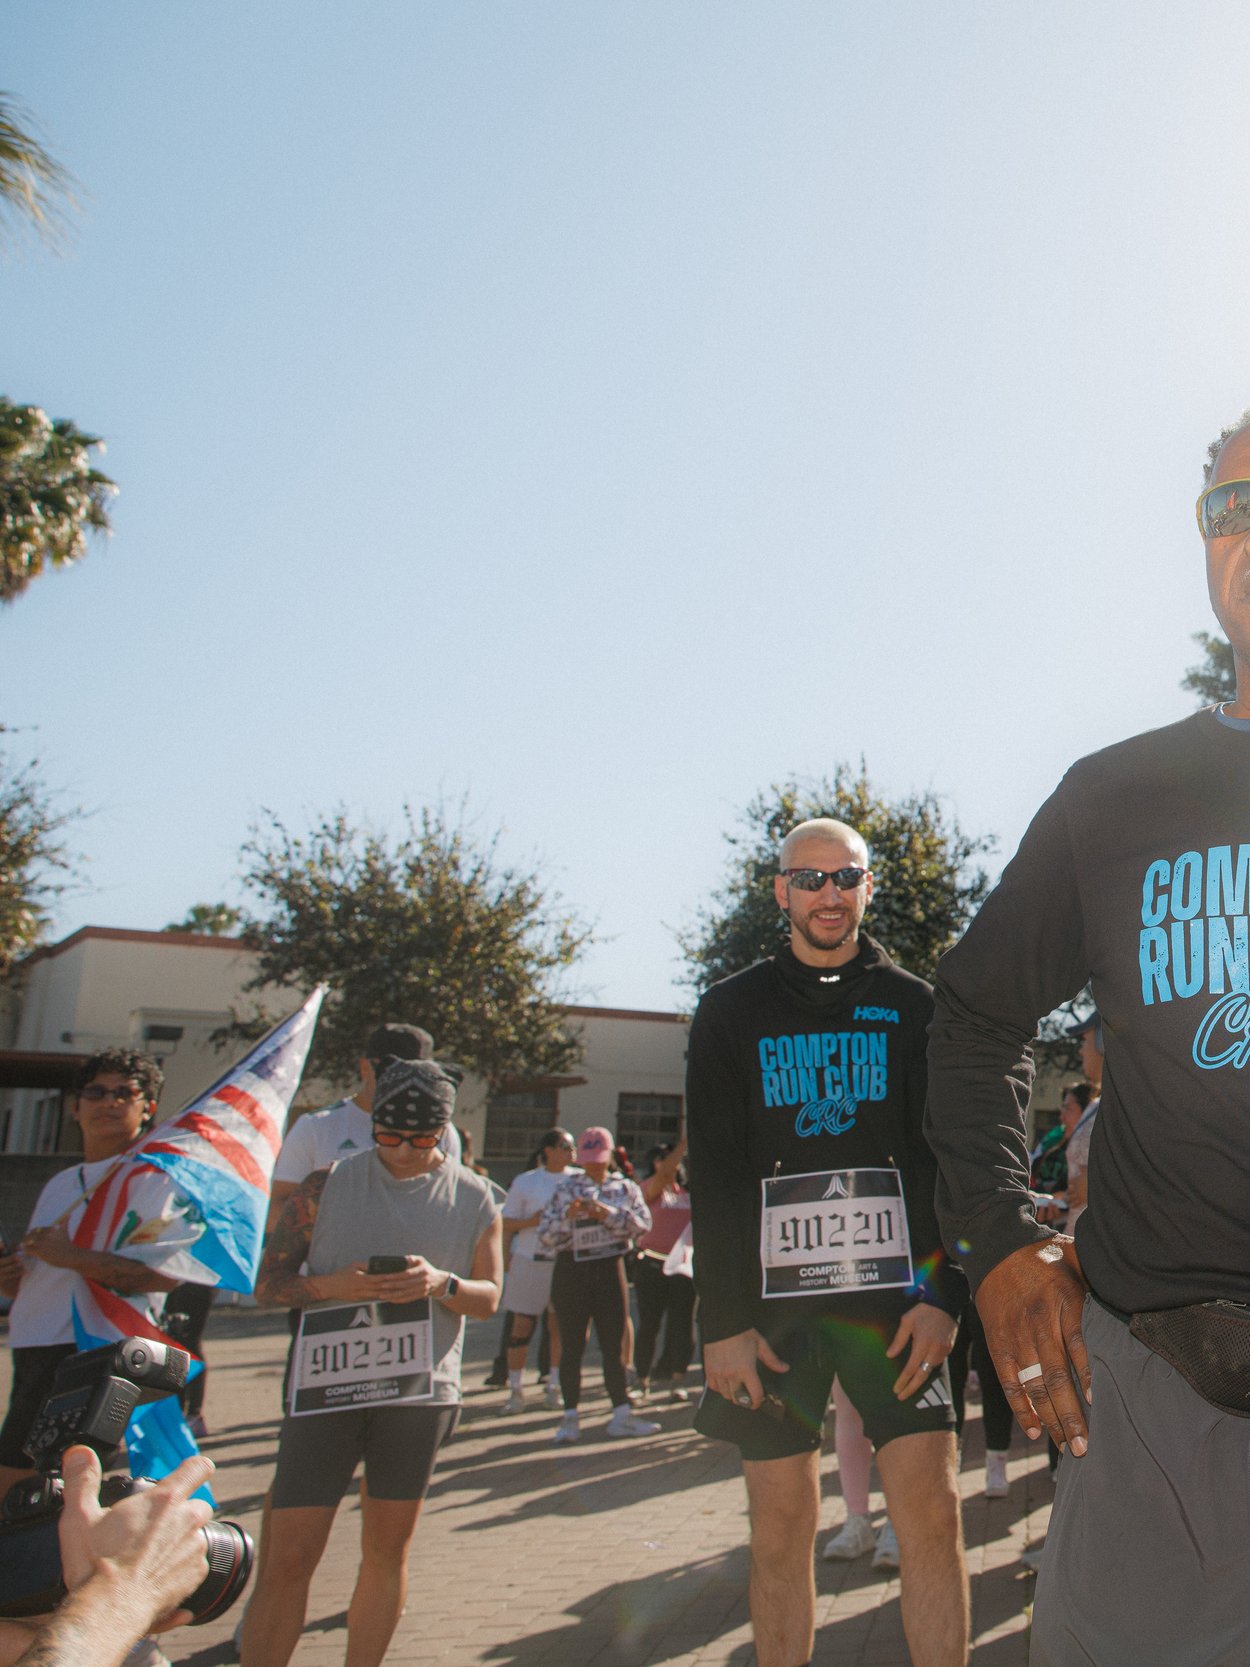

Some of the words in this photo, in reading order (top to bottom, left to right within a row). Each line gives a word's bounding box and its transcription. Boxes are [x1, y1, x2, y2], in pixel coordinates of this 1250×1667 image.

[1138, 915, 1249, 1006] RUN
[853, 1005, 900, 1025] HOKA
[758, 1031, 888, 1072] COMPTON
[762, 1067, 819, 1108] RUN
[824, 1064, 888, 1102] CLUB
[795, 1096, 860, 1138] CRC
[779, 1208, 895, 1253] 90220
[800, 1262, 856, 1278] COMPTON
[858, 1263, 872, 1271] ART
[829, 1271, 880, 1286] MUSEUM
[310, 1332, 417, 1376] 90220
[324, 1382, 378, 1397] COMPTON
[353, 1387, 399, 1402] MUSEUM
